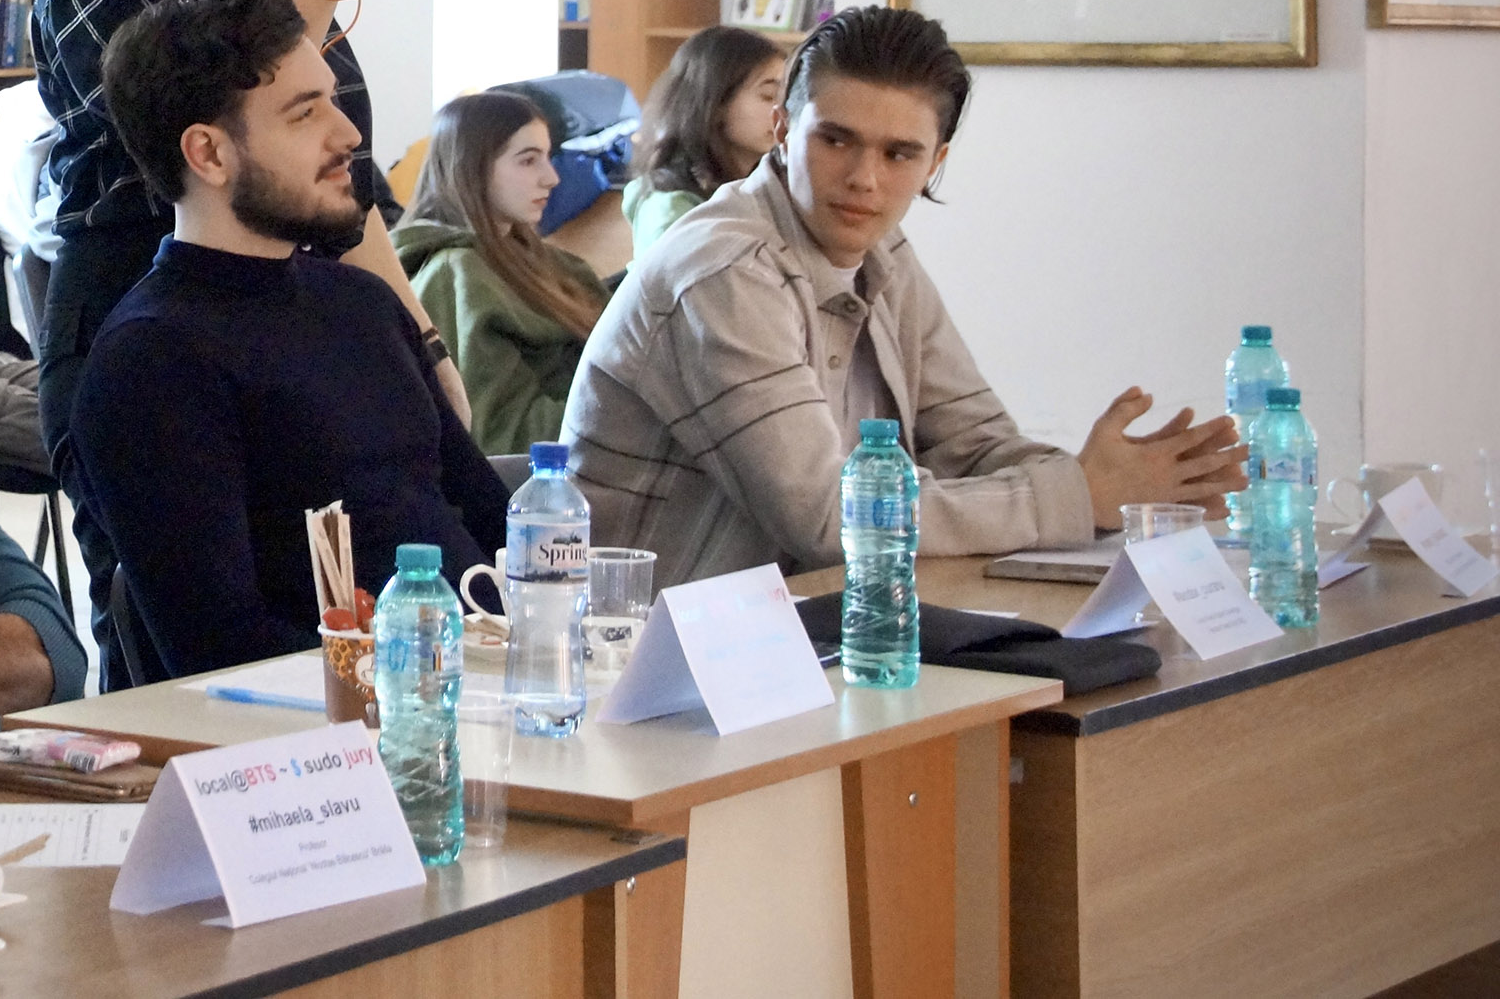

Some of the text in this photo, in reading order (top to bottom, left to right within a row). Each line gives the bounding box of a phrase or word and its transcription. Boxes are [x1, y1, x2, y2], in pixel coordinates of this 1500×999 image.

[194, 763, 277, 795] local@BTS
[303, 752, 342, 774] sudo
[342, 747, 373, 770] jury
[247, 797, 361, 833] #mihaela_slavu
